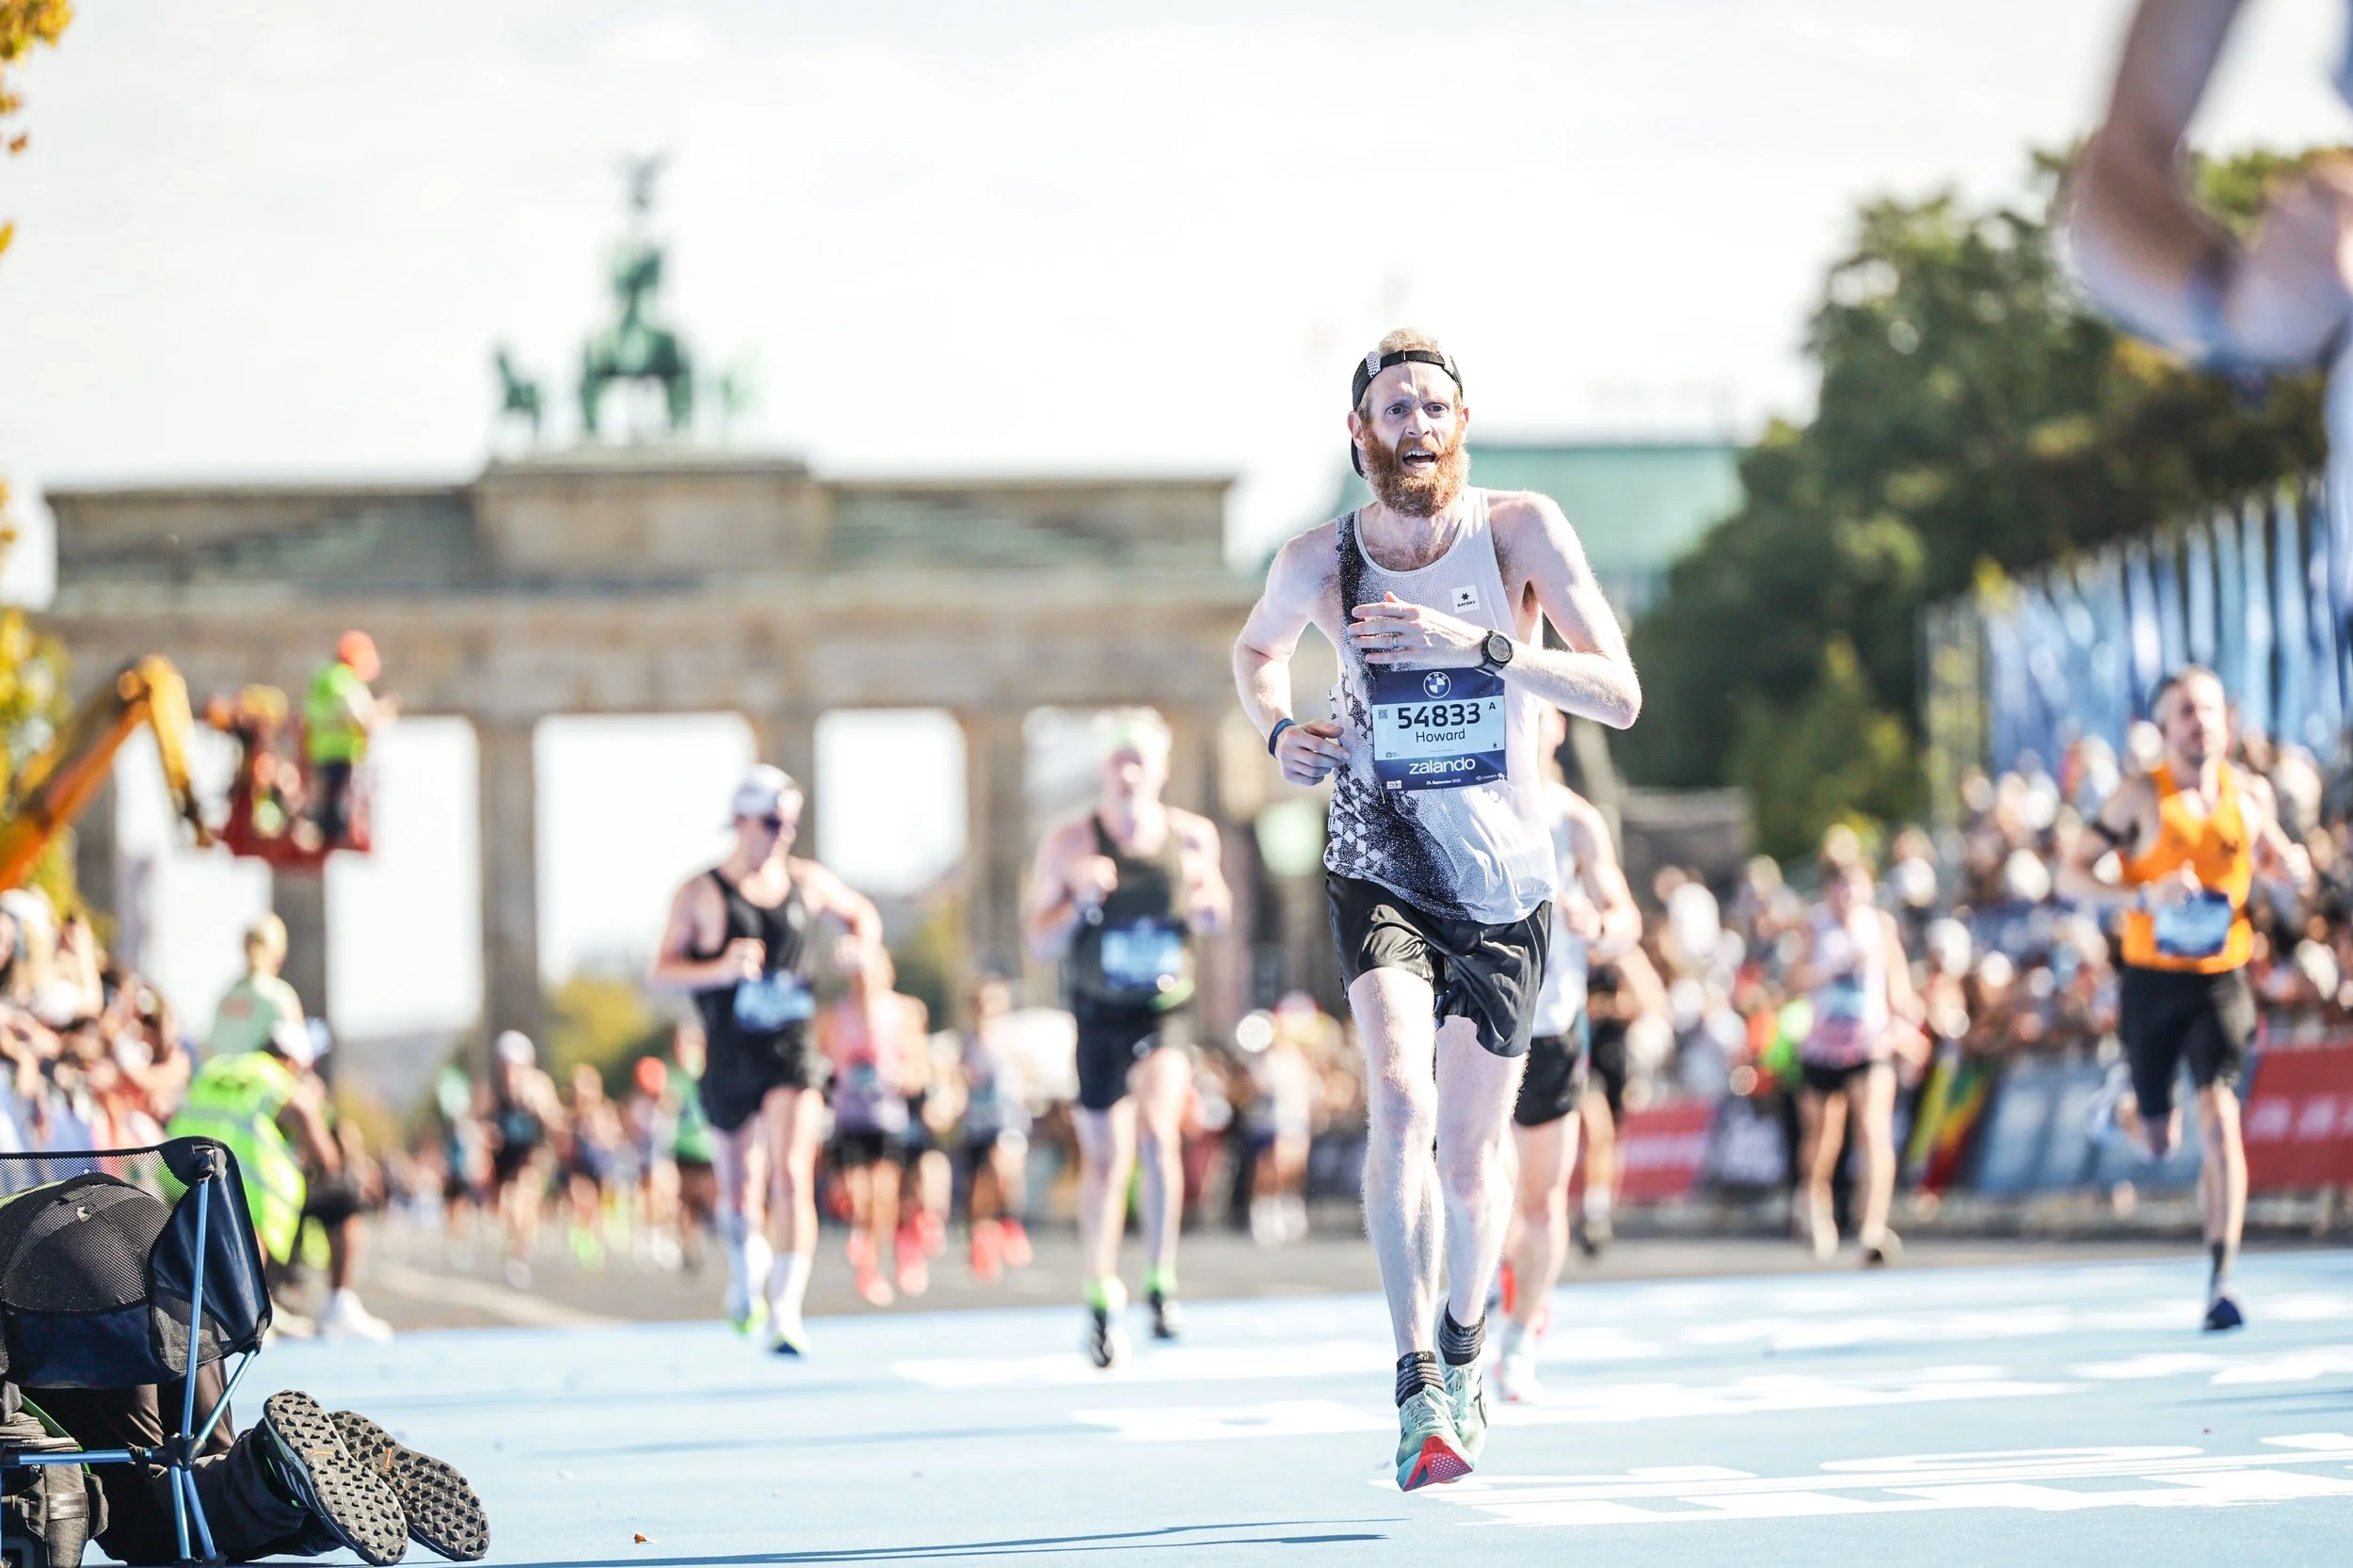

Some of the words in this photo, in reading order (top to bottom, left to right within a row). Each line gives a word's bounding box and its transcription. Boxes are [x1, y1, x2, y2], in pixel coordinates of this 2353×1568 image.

[1397, 703, 1481, 729] 54833
[1488, 702, 1496, 711] A
[1416, 728, 1465, 743] Howard
[1409, 758, 1476, 775] zalando
